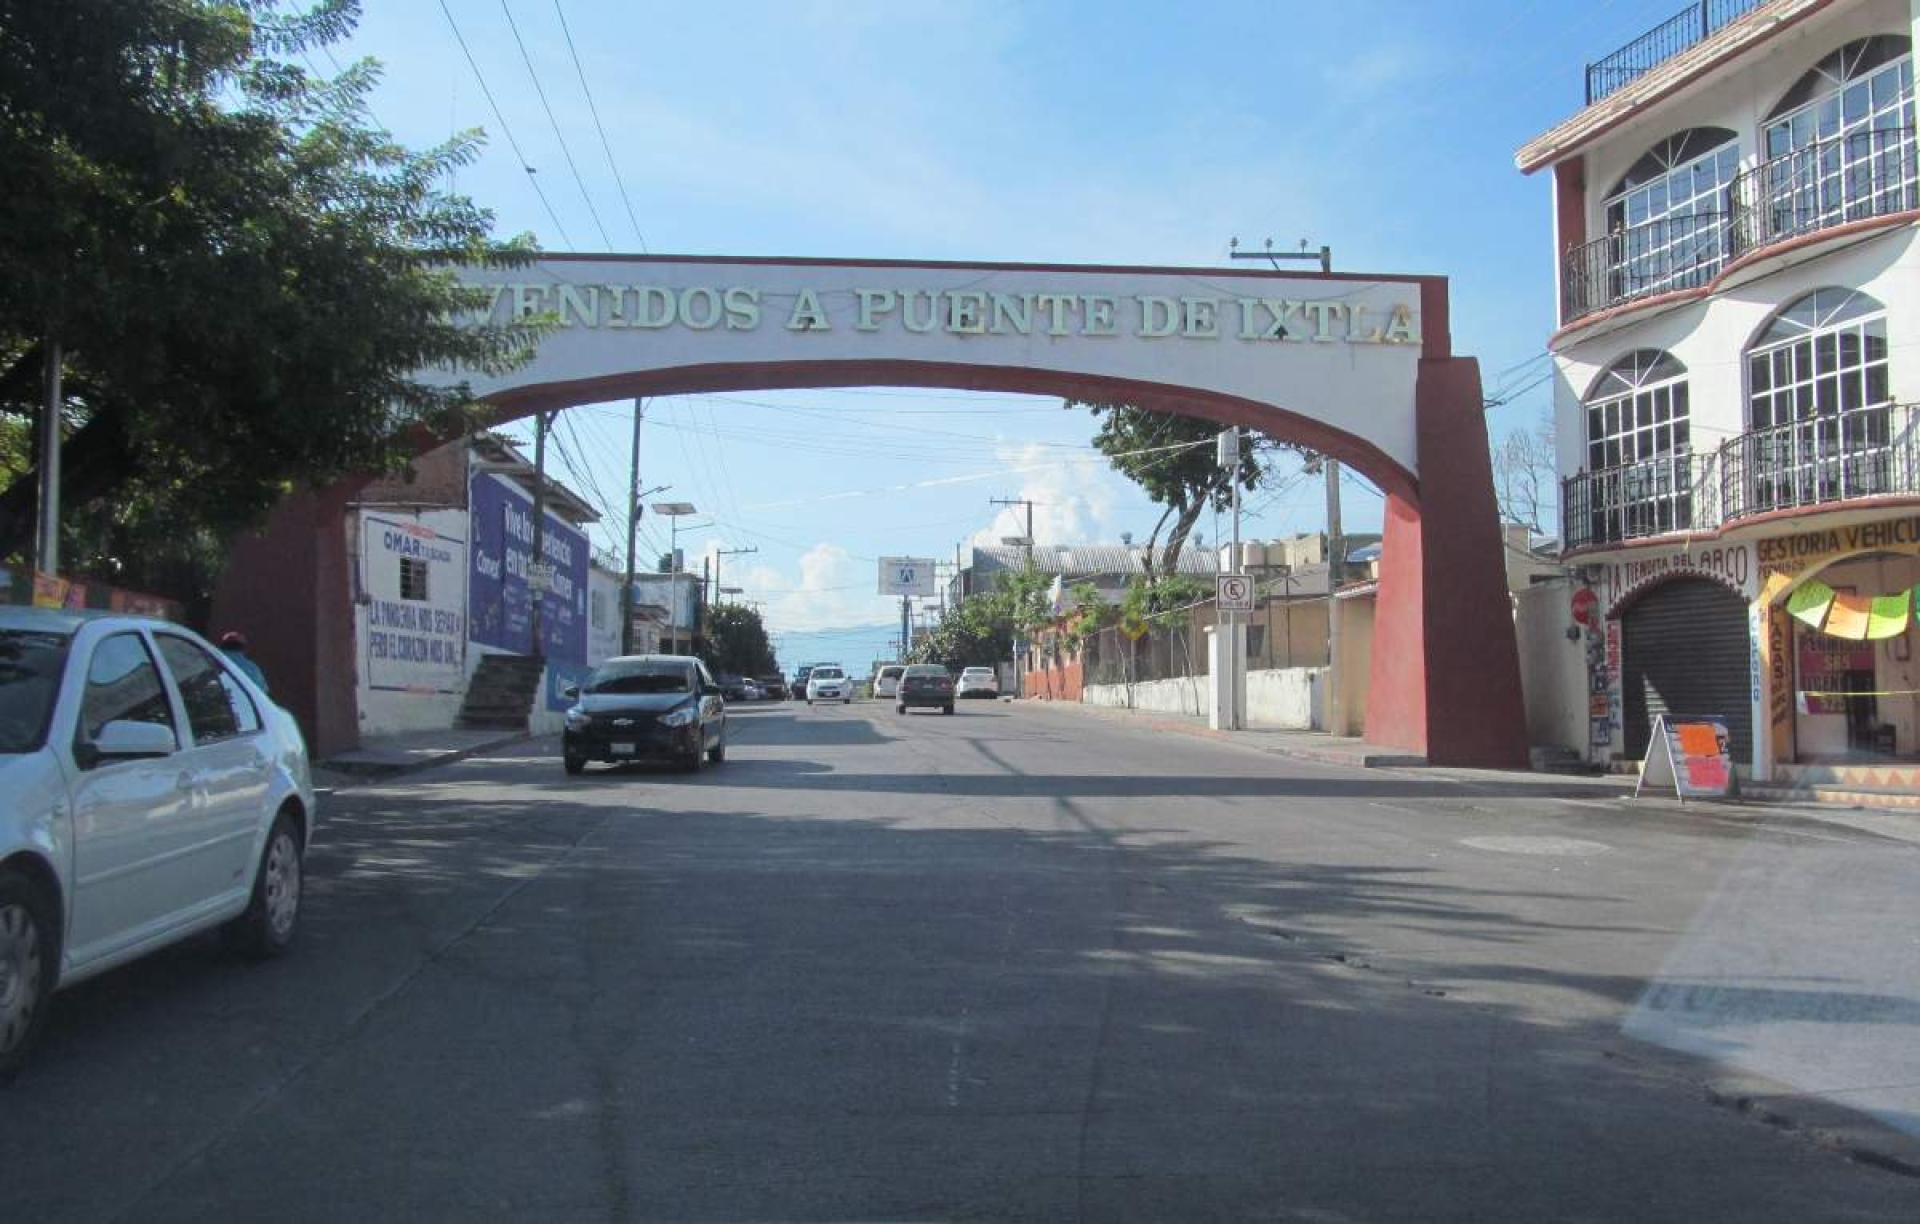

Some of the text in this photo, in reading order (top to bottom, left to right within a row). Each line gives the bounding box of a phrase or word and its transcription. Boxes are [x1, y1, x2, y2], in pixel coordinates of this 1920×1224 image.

[455, 282, 1422, 345] VENIDOS A PUENTE DE IXTLA
[383, 530, 420, 557] OMAR
[1757, 530, 1841, 562] GESTORIA
[1607, 564, 1622, 604] LA
[1673, 552, 1695, 568] DEL
[1700, 545, 1748, 585] ARCO
